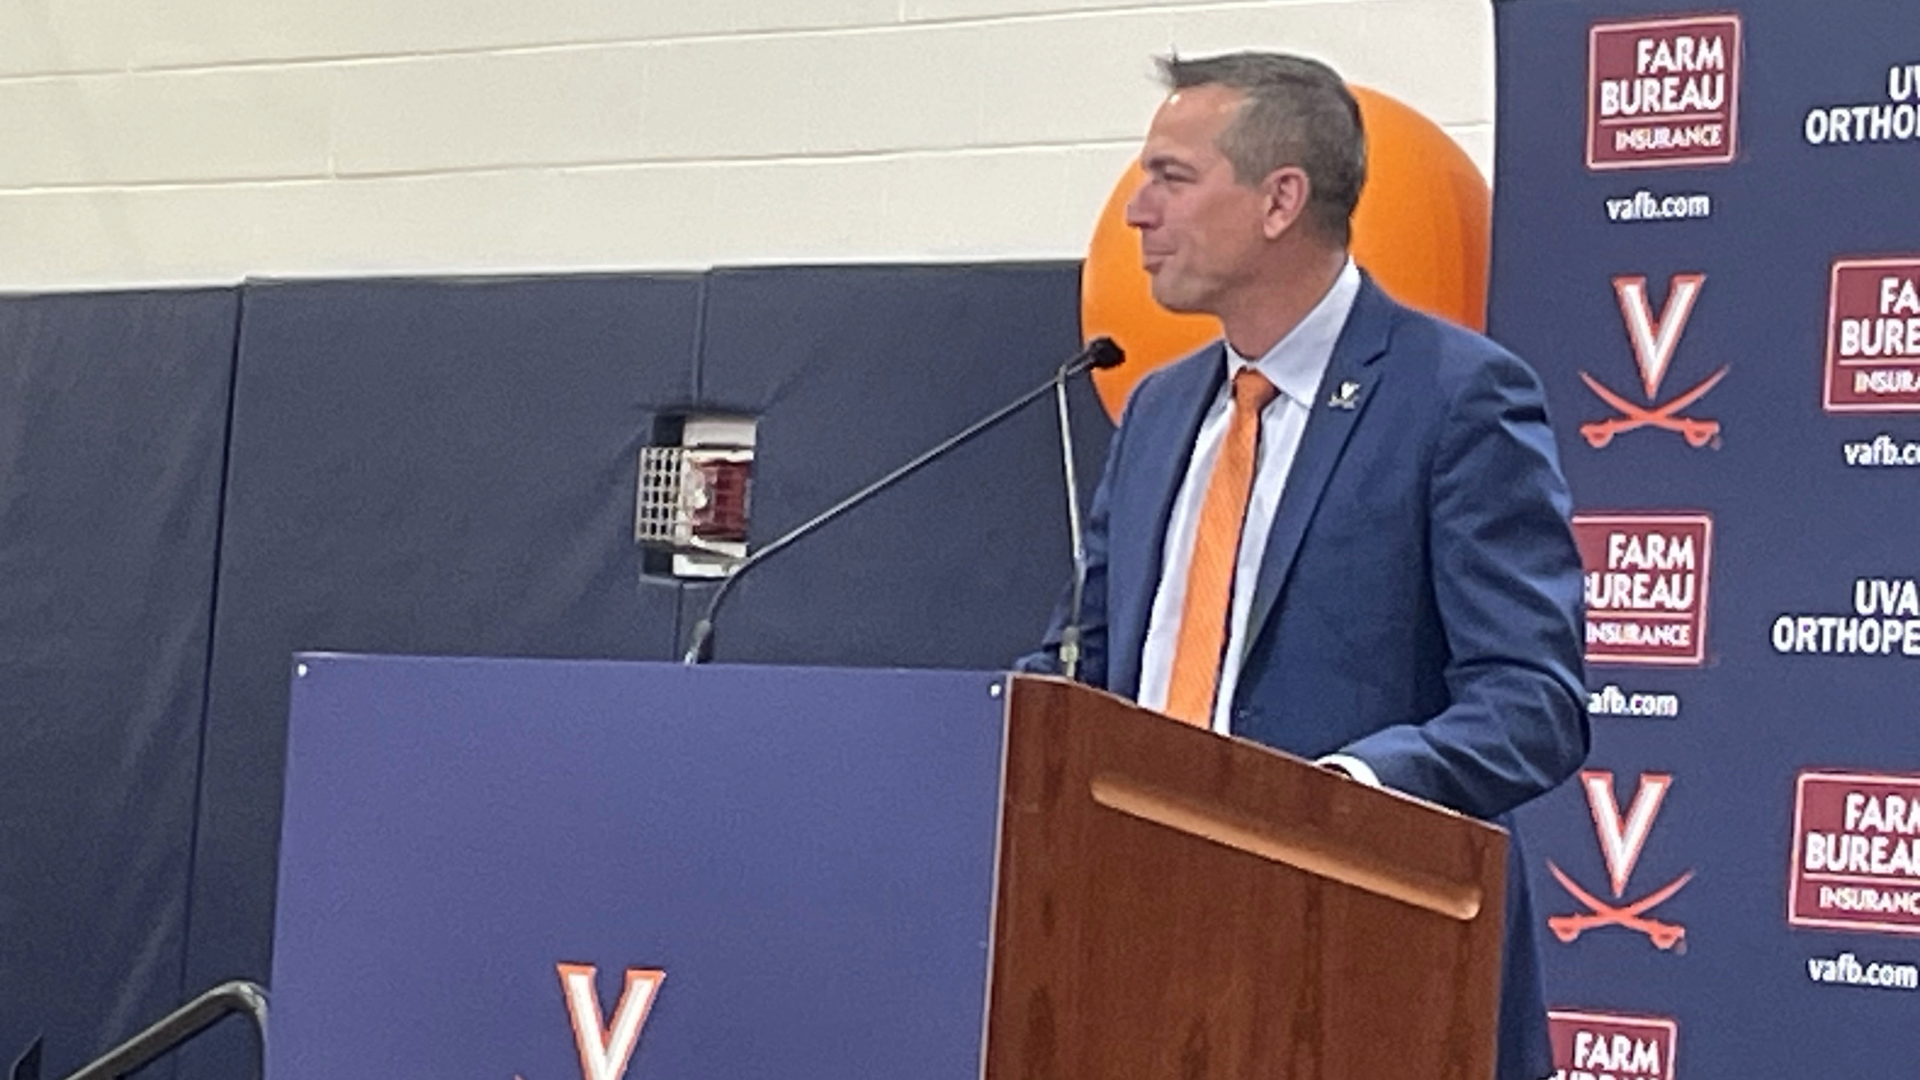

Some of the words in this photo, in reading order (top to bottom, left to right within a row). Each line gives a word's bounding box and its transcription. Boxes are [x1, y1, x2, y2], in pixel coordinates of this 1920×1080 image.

[1637, 37, 1724, 74] FARM
[1600, 74, 1725, 116] BUREAU
[1615, 124, 1722, 151] INSURANCE
[1606, 191, 1710, 220] vafb.com
[1840, 317, 1920, 356] BURE
[1608, 532, 1695, 570] FARM
[1856, 579, 1920, 617] UVA
[1585, 621, 1691, 647] INSURANCE
[1773, 616, 1920, 655] ORTHOPE
[1808, 953, 1918, 989] vafb.com
[1574, 1030, 1660, 1075] FARM
